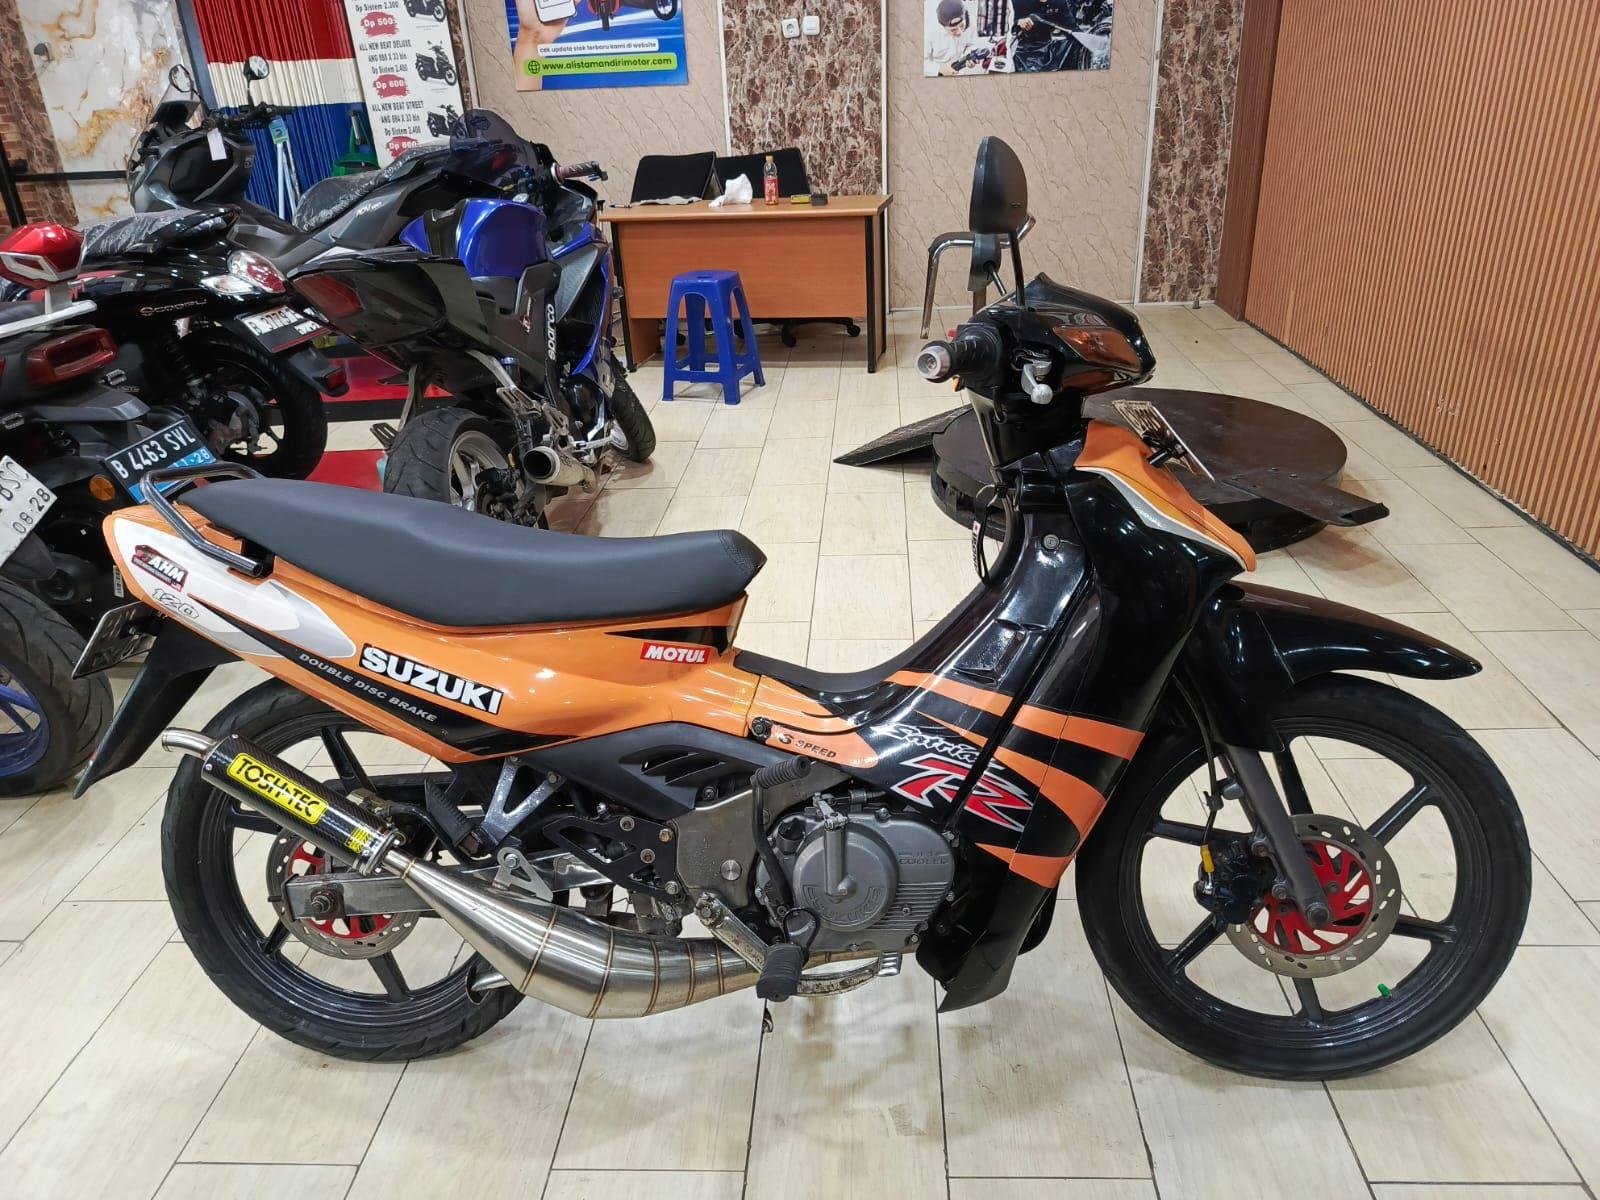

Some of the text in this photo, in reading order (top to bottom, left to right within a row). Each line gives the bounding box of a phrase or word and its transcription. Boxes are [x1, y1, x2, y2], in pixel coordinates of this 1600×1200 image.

[364, 17, 393, 28] Dp 500
[360, 39, 412, 51] ALL NEW BEAT DELUXE
[542, 57, 672, 71] www.alistamandirimotor.com
[376, 78, 404, 90] Dp 600
[372, 100, 424, 112] ALL NEW BEAT STREET
[388, 142, 400, 150] Dp
[547, 303, 556, 361] sparco
[110, 426, 196, 479] B 4463 SVL
[148, 556, 185, 583] AHM
[644, 645, 706, 663] MOTUL
[299, 653, 438, 723] DOUBLE DISC BRAKE
[361, 646, 502, 714] SUZUKI
[795, 739, 837, 758] SPEED
